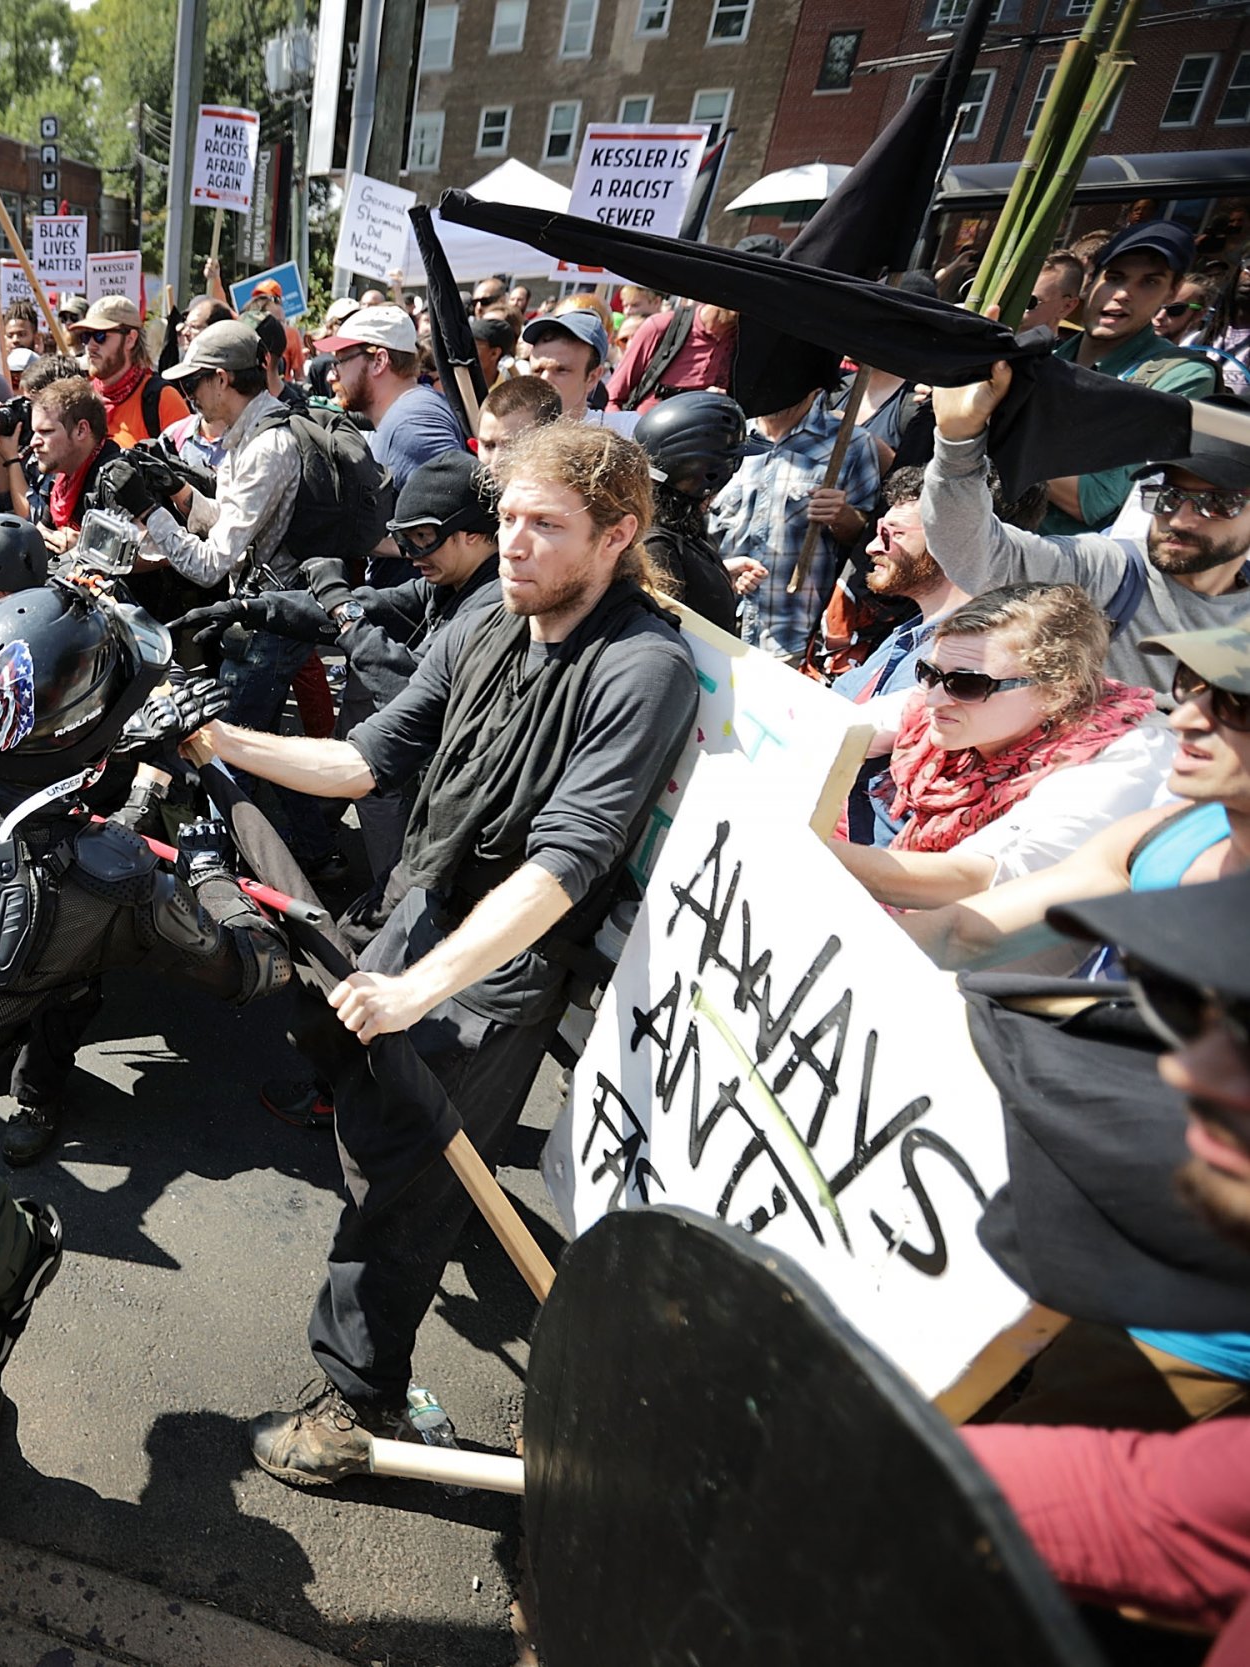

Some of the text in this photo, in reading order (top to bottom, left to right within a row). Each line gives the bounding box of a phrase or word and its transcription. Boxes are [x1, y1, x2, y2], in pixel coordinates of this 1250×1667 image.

[214, 124, 246, 142] MAKE
[205, 139, 249, 159] RACISTS
[590, 148, 690, 168] KESSLER IS
[206, 156, 246, 175] AFRAID
[207, 174, 242, 192] AGAIN
[590, 179, 674, 199] A RACIST
[252, 150, 271, 261] Downtown Mall
[361, 185, 406, 216] General
[357, 203, 403, 233] Sherman
[596, 207, 655, 227] SEWER
[40, 223, 79, 238] BLACK
[366, 224, 383, 239] Did
[43, 240, 76, 255] LIVES
[350, 231, 392, 263] Nothing
[38, 258, 82, 271] MATTER
[92, 262, 135, 273] KKKESSLER
[354, 250, 386, 278] Wrong
[99, 275, 126, 286] IS NAZI
[46, 777, 81, 797] UNDER
[667, 819, 989, 1278] ALWAYS
